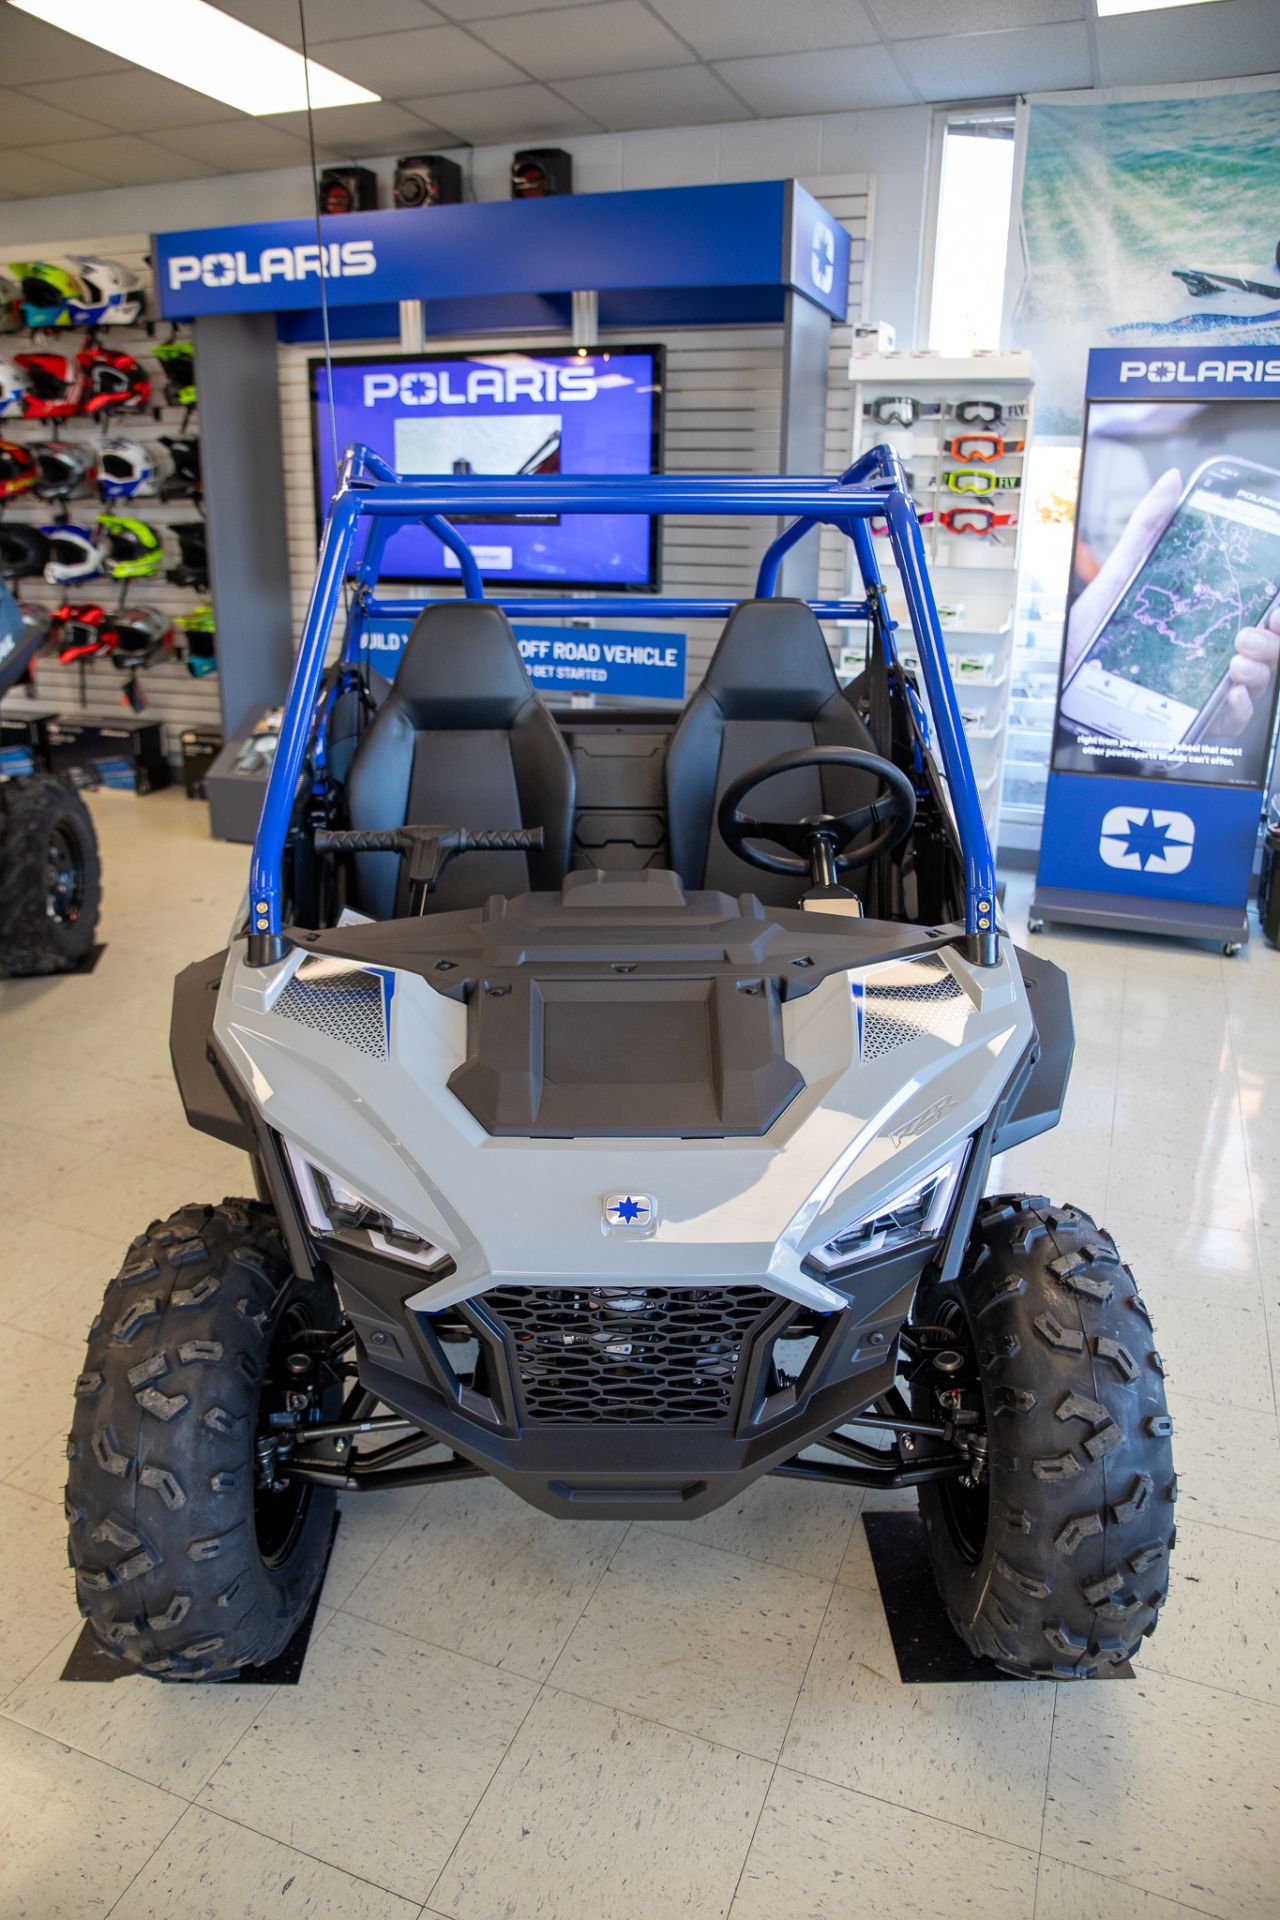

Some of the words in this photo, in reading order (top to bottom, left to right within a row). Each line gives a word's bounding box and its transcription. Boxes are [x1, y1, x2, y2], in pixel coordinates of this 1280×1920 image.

[168, 240, 377, 290] POLARIS
[1120, 360, 1280, 382] POLARIS
[363, 366, 598, 407] POLARIS
[1008, 404, 1025, 417] FLY
[1000, 477, 1017, 489] FLY
[518, 640, 549, 658] OFF
[553, 642, 600, 661] ROAD
[603, 645, 678, 666] VEHICLE
[533, 664, 554, 678] GET
[555, 666, 608, 681] STARTED
[1077, 735, 1098, 746] right
[1098, 736, 1119, 746] from
[1175, 743, 1200, 753] wheel
[1201, 744, 1219, 754] that
[1220, 747, 1243, 756] most
[1082, 746, 1105, 755] other
[1105, 748, 1158, 760] powersports
[1188, 754, 1210, 764] can't
[1210, 756, 1234, 766] offer.
